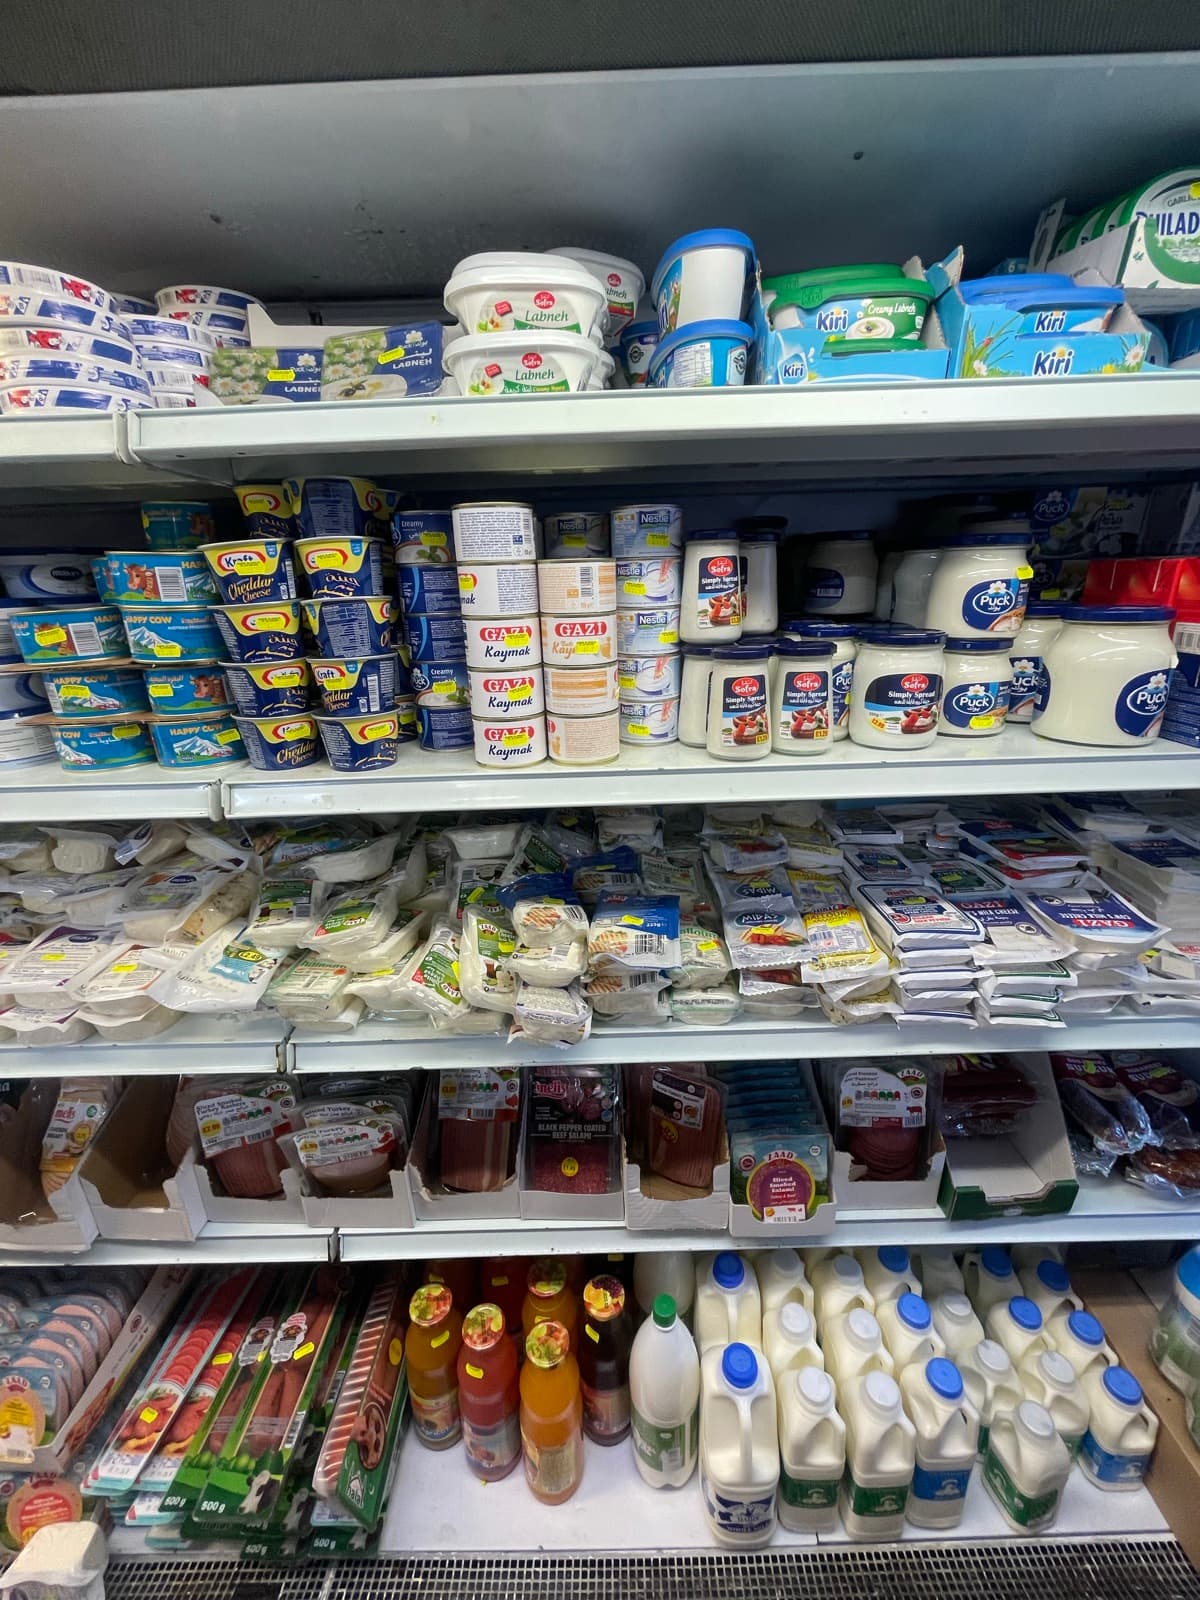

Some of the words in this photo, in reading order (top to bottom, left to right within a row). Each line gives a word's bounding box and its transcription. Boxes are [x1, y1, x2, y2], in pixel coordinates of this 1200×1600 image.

[605, 287, 627, 299] abneh
[536, 299, 553, 308] Sofra
[868, 304, 893, 316] Creamy
[893, 303, 917, 314] Labneh
[525, 310, 568, 321] Labneh
[817, 310, 848, 331] Kiri
[1035, 313, 1065, 332] Kiri
[392, 358, 433, 370] LABNEH
[1034, 352, 1073, 375] Kiri
[515, 369, 555, 380] Labneh
[783, 363, 804, 378] Kiri
[401, 520, 424, 530] Creamy
[710, 564, 733, 575] Sofra
[228, 576, 275, 600] Cheddar
[242, 588, 272, 603] Cheese
[461, 593, 476, 605] mak
[979, 594, 1011, 607] Puck
[149, 616, 172, 624] COW
[559, 622, 605, 636] GAZI
[484, 645, 531, 662] Kaymak
[551, 641, 575, 660] Kay
[430, 667, 454, 678] Creamy
[797, 679, 821, 690] Sofra
[836, 676, 851, 687] Puc
[1013, 674, 1039, 685] uck
[735, 683, 758, 694] Sofra
[902, 681, 926, 690] Sofra
[324, 690, 354, 705] eddar
[786, 691, 807, 700] Simply
[808, 690, 827, 699] Spread
[887, 690, 914, 699] Simply
[914, 689, 935, 699] Spread
[1138, 691, 1168, 703] Puck
[487, 695, 533, 712] Kaymak
[725, 696, 747, 705] Simply
[958, 696, 991, 708] Puck
[170, 726, 200, 737] HAPPY
[488, 744, 533, 761] Kaymak
[961, 900, 1004, 909] GAZI
[742, 912, 778, 923] MIDAS
[1078, 918, 1130, 929] GAZI
[538, 1123, 558, 1131] BLACK
[560, 1123, 582, 1132] PEPPER
[584, 1124, 606, 1132] COATED
[552, 1131, 567, 1139] BEEF
